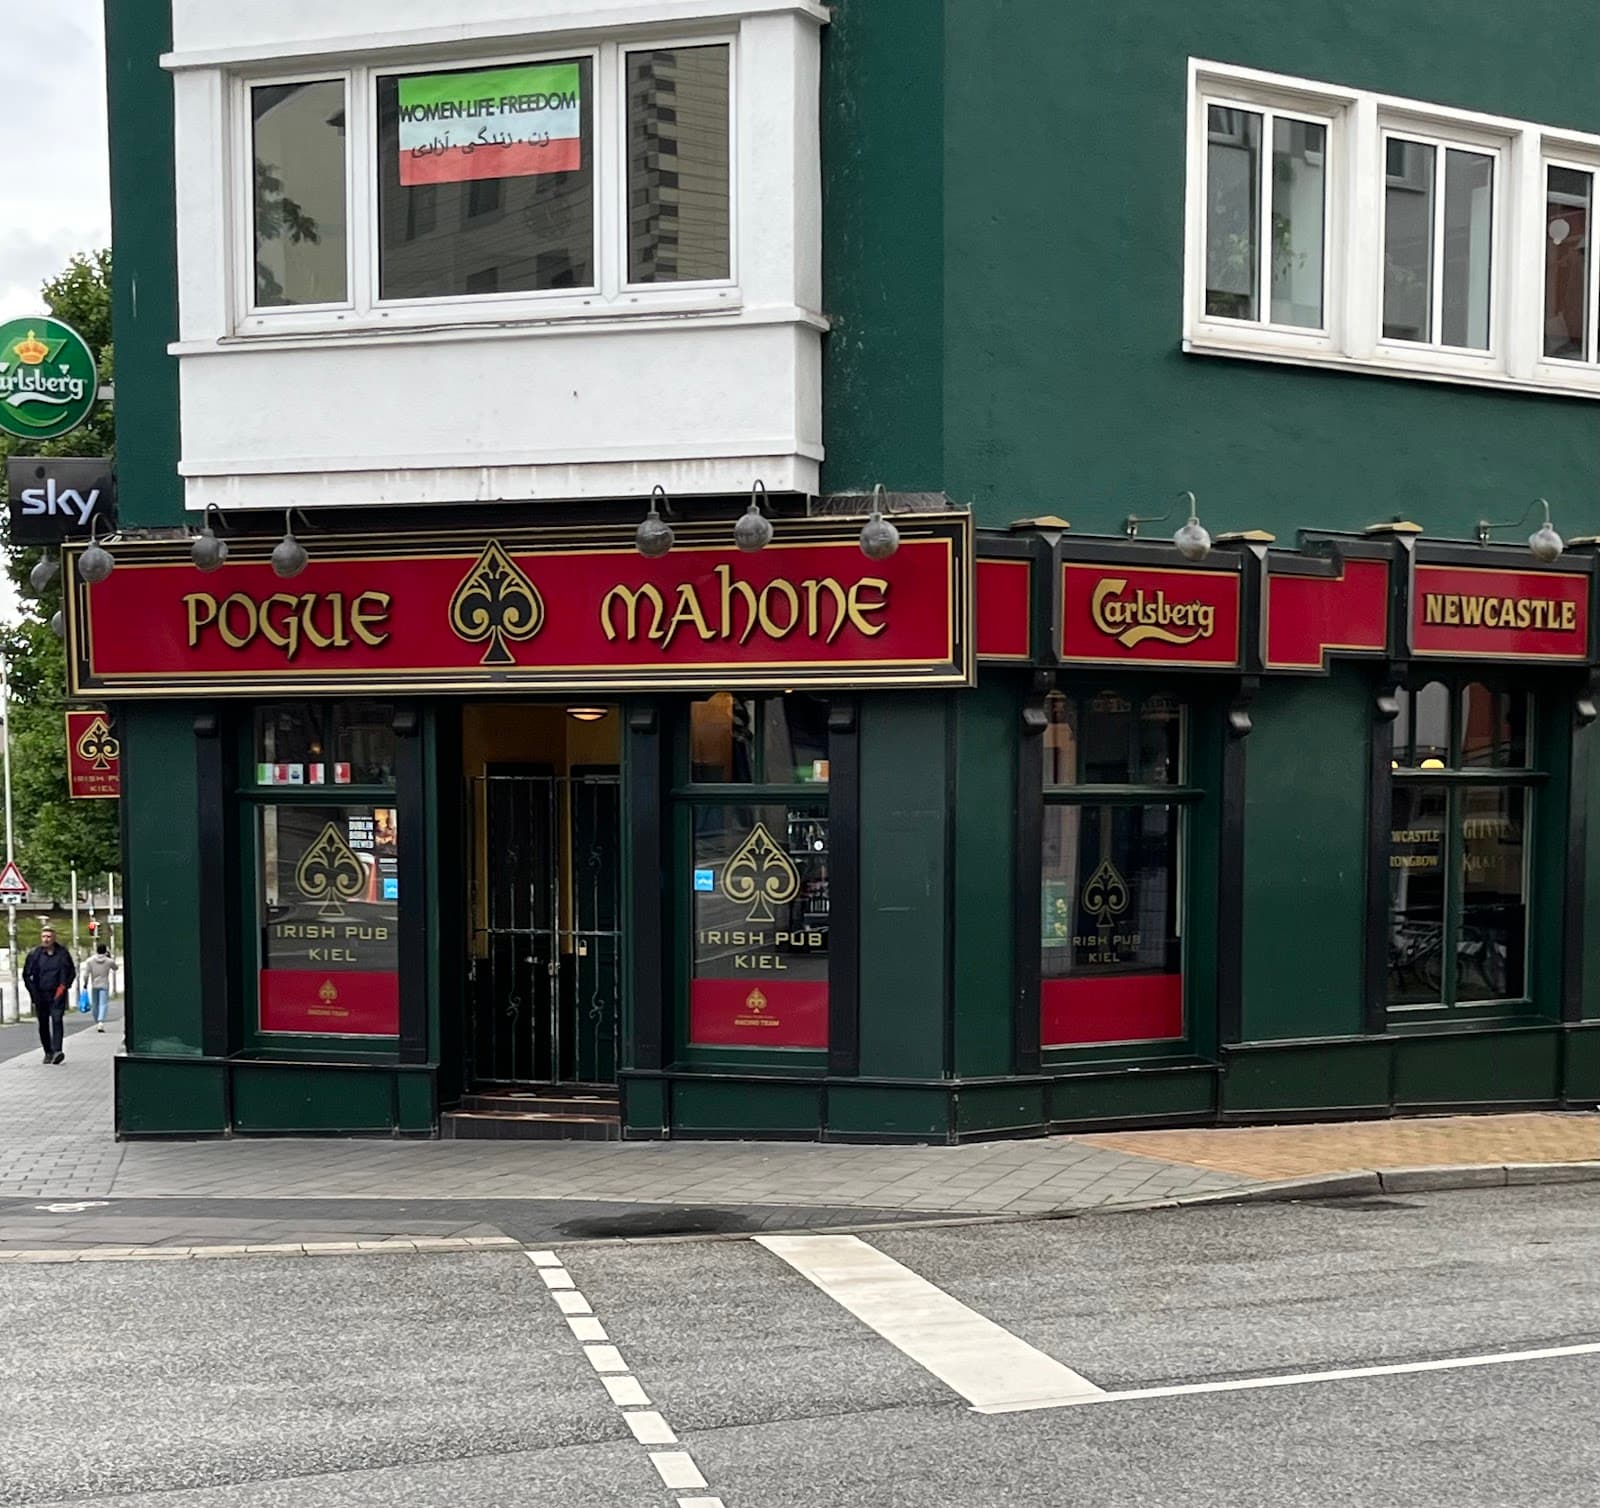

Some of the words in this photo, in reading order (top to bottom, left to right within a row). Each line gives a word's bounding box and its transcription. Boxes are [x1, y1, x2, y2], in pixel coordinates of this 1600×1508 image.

[0, 363, 84, 400] arlsberg
[21, 479, 99, 525] sky
[1092, 578, 1215, 642] Carlsberg
[1426, 594, 1576, 630] NEWCASTLE
[183, 591, 390, 660] POGUE
[277, 925, 335, 938] IRISH
[345, 926, 388, 940] PUB
[700, 931, 764, 944] IRISH
[775, 932, 823, 946] PUB
[1068, 936, 1108, 948] RISH
[1113, 934, 1141, 946] PUB
[309, 949, 357, 961] KIEL
[735, 955, 788, 969] KIEL
[1089, 952, 1121, 963] KIEL
